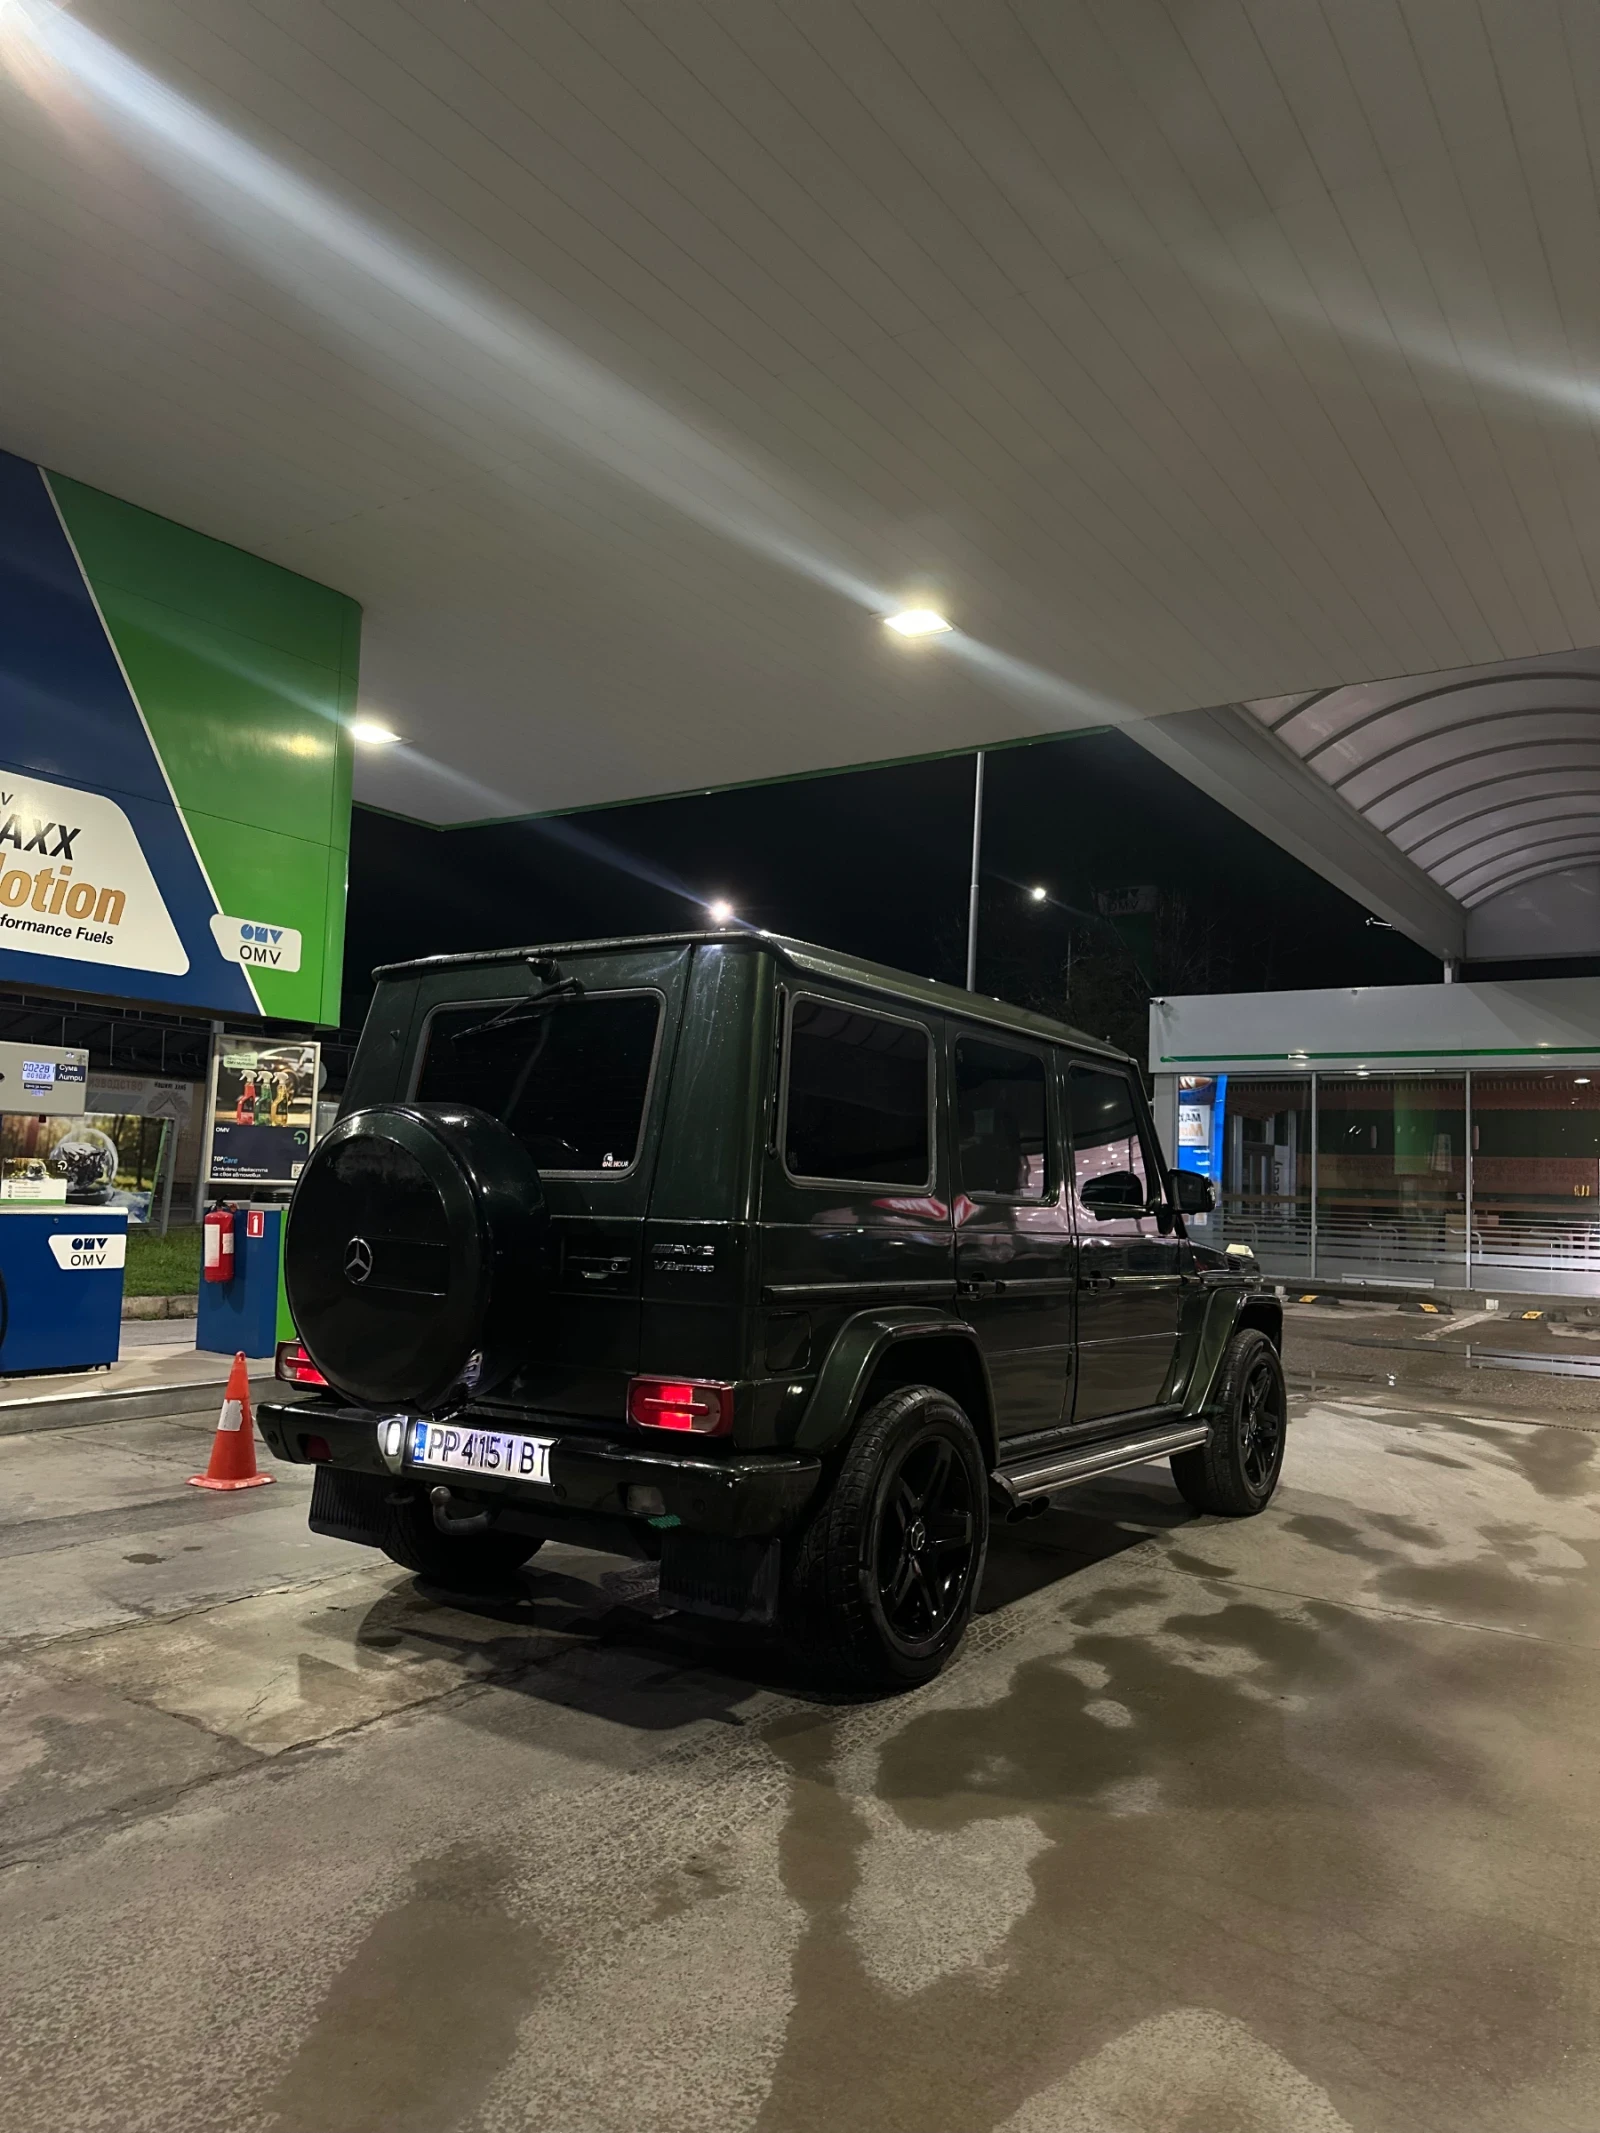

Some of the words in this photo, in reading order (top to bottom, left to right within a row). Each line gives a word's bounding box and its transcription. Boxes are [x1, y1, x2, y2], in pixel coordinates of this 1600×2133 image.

[0, 811, 81, 860] AXX
[0, 852, 126, 925] otion
[76, 927, 114, 945] Fuels
[240, 945, 281, 965] OMV
[58, 1073, 83, 1082] Литри
[59, 1064, 78, 1073] Сума
[71, 1254, 106, 1266] OMV
[461, 1433, 514, 1471] 4151
